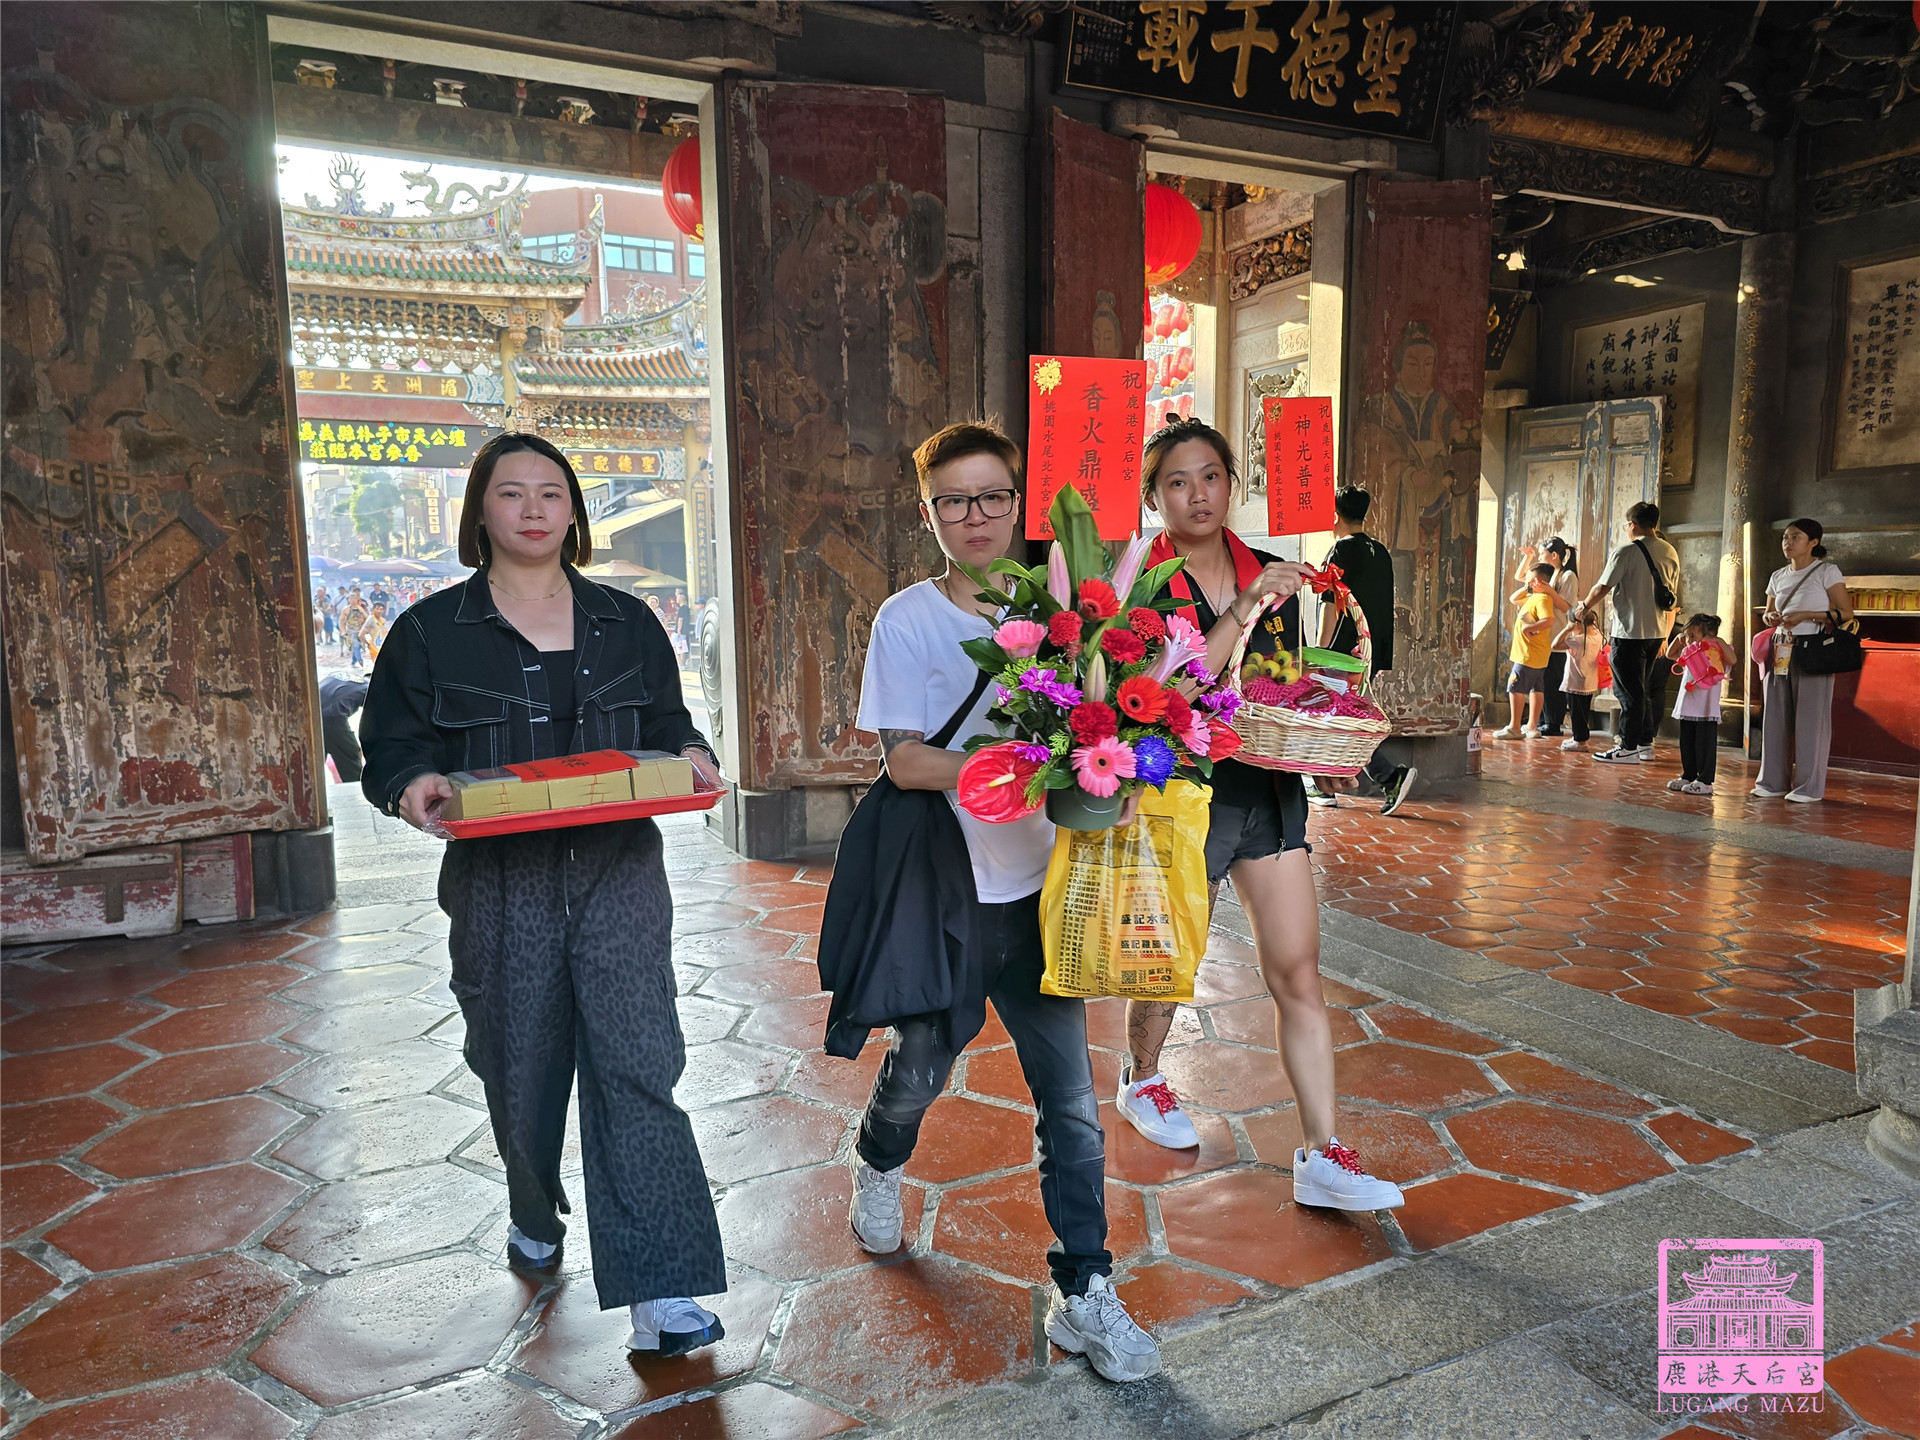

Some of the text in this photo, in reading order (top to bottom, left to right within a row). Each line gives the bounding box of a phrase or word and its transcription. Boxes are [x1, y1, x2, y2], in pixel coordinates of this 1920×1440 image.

[1077, 382, 1109, 512] 香火鼎盛
[1295, 414, 1313, 512] 神光普照
[1120, 913, 1170, 925] 盛記水餃
